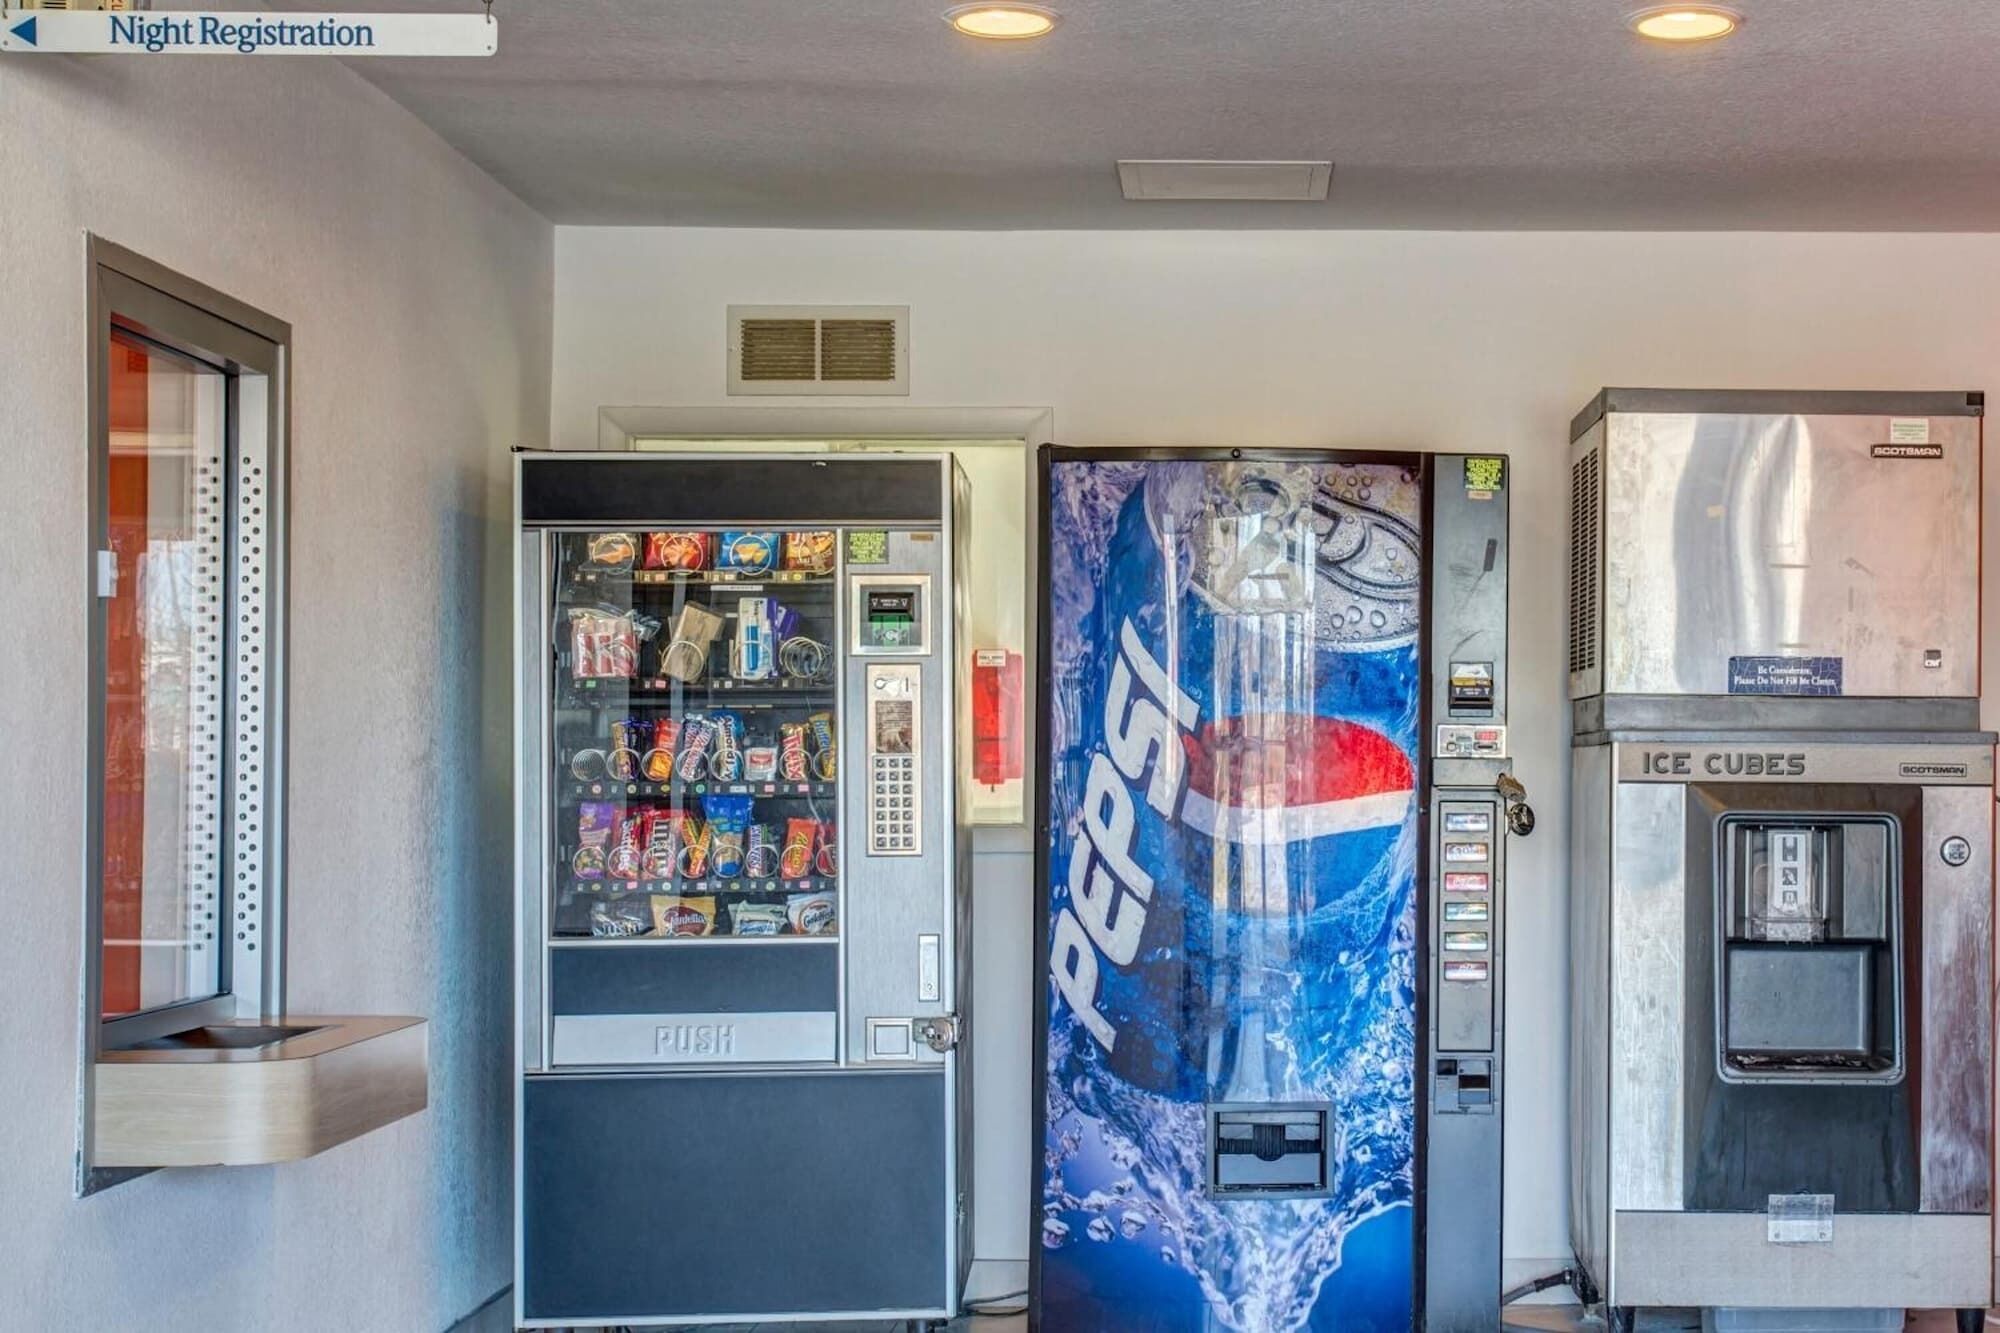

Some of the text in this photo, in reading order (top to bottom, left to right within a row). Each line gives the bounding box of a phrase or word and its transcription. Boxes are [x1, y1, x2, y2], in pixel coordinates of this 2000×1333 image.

[110, 15, 374, 53] Night Registration
[1874, 447, 1941, 456] SCOTSMAN
[1734, 676, 1755, 685] Please
[1757, 676, 1769, 685] Do
[1643, 752, 1805, 776] ICE CUBES
[1902, 765, 1964, 775] SCOTSMAN
[1050, 614, 1200, 1054] PEPSI
[655, 1025, 736, 1056] PUSH
